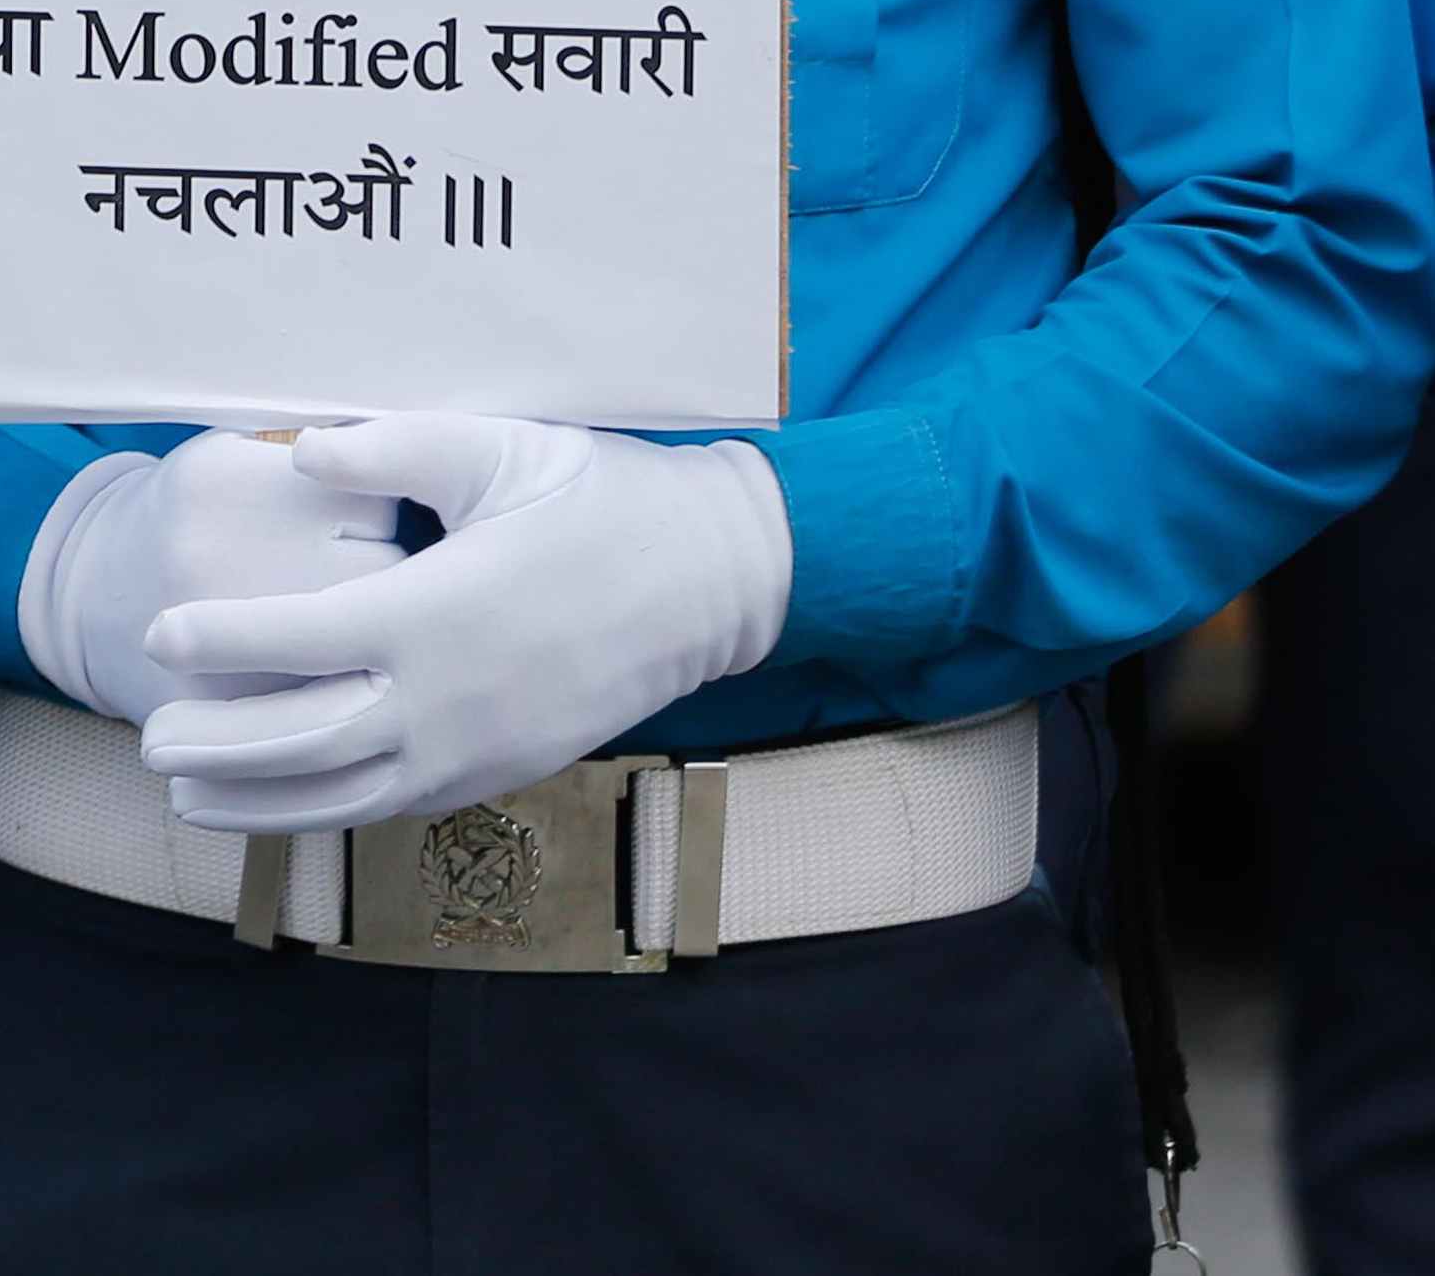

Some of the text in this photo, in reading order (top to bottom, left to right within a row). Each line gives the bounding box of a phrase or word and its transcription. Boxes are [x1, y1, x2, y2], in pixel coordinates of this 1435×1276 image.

[76, 10, 463, 91] Modified
[485, 6, 707, 97] सवारी
[79, 143, 416, 241] नचलाऔं
